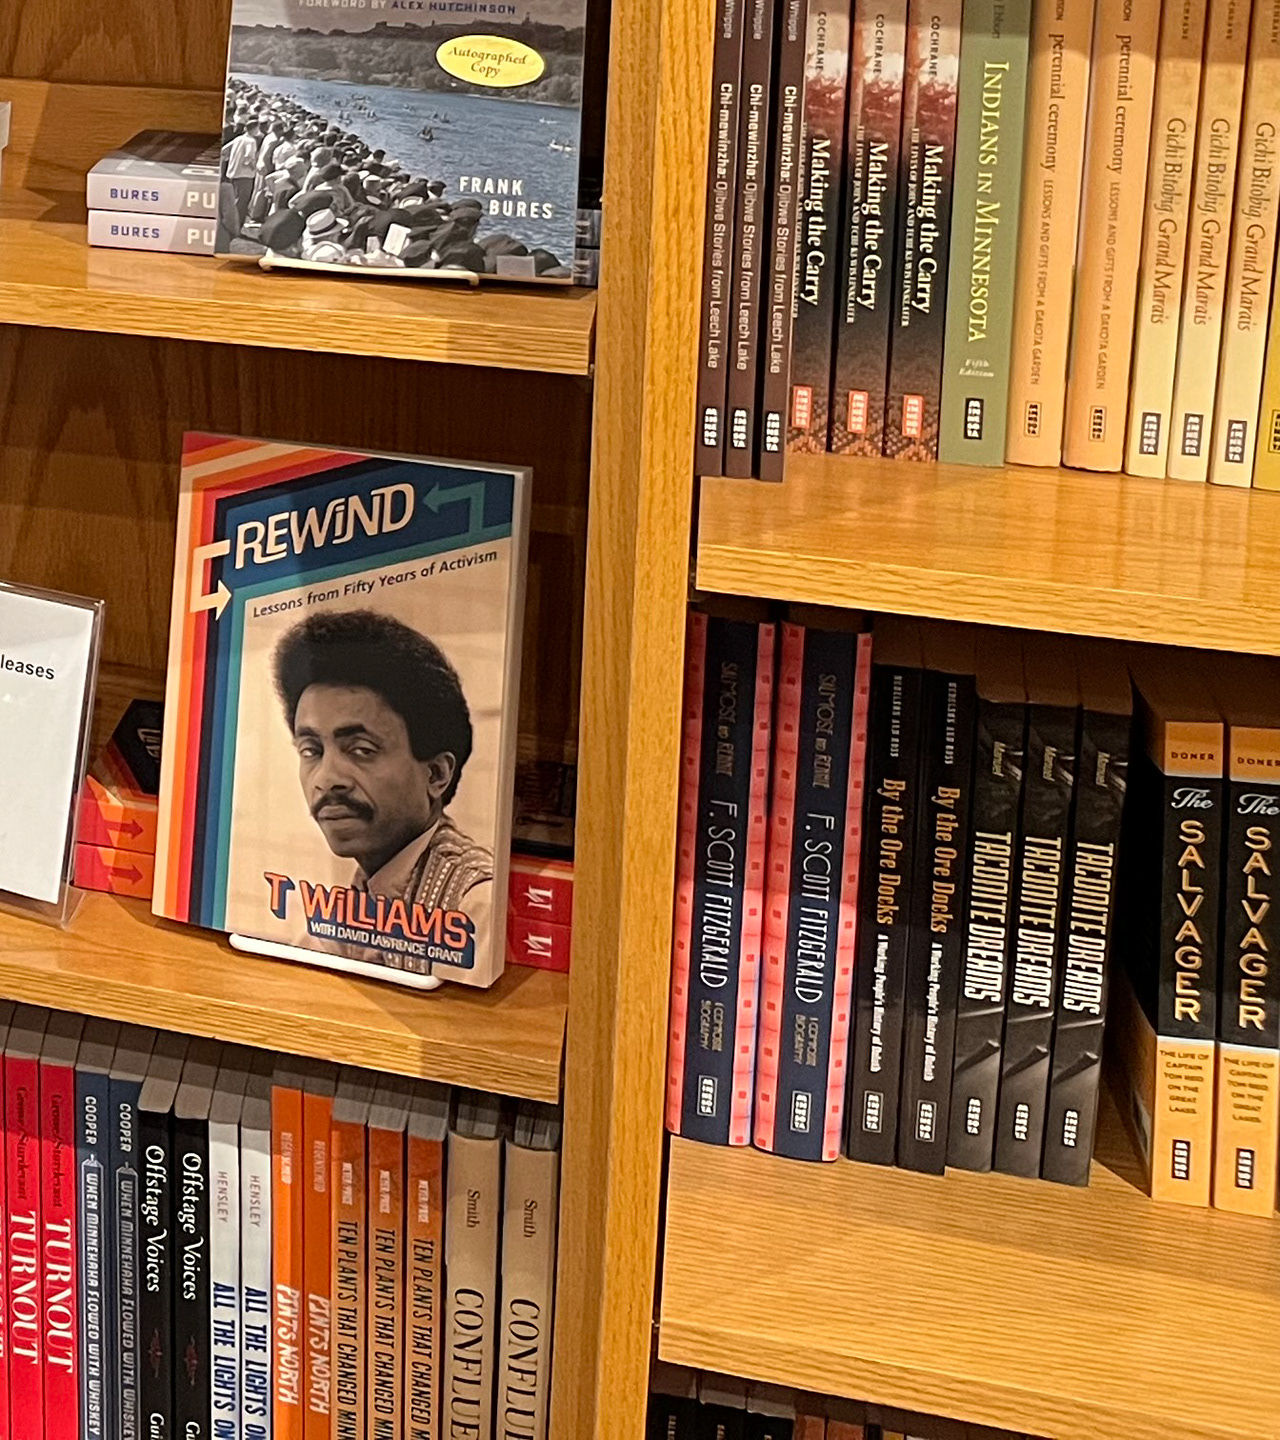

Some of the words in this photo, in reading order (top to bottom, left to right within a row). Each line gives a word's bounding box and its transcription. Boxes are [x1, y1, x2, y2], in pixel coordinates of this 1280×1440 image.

[371, 0, 386, 10] BY
[391, 1, 424, 11] ALEX
[429, 1, 516, 15] HUTCHINSON
[448, 46, 528, 67] Autographed
[471, 61, 500, 78] Copy
[978, 60, 1010, 166] INDIANS
[109, 188, 159, 203] BURES
[459, 176, 523, 197] FRANK
[916, 144, 944, 218] Making
[977, 173, 991, 194] IN
[489, 200, 553, 219] BURES
[920, 224, 939, 254] the
[911, 259, 937, 314] Carry
[969, 201, 1002, 345] MINNESOTA
[253, 598, 303, 619] Lessons
[307, 590, 339, 607] from
[343, 577, 376, 600] Fifty
[379, 569, 417, 589] Years
[421, 563, 436, 578] of
[440, 549, 498, 575] Activism
[877, 778, 906, 802] By
[1171, 787, 1214, 809] The
[806, 813, 835, 831] F.
[881, 808, 904, 834] the
[800, 839, 832, 902] SCOTT
[880, 839, 903, 869] Ore
[970, 831, 1012, 923] TACONITE
[264, 872, 291, 914] T
[876, 872, 901, 926] Docks
[1175, 820, 1206, 1023] SALVAGER
[794, 907, 829, 1004] FITZGERALD
[964, 923, 1006, 1002] DREAMS
[140, 1144, 166, 1228] Offstage
[145, 1227, 171, 1293] Voices
[44, 1218, 74, 1374] TURNOUT
